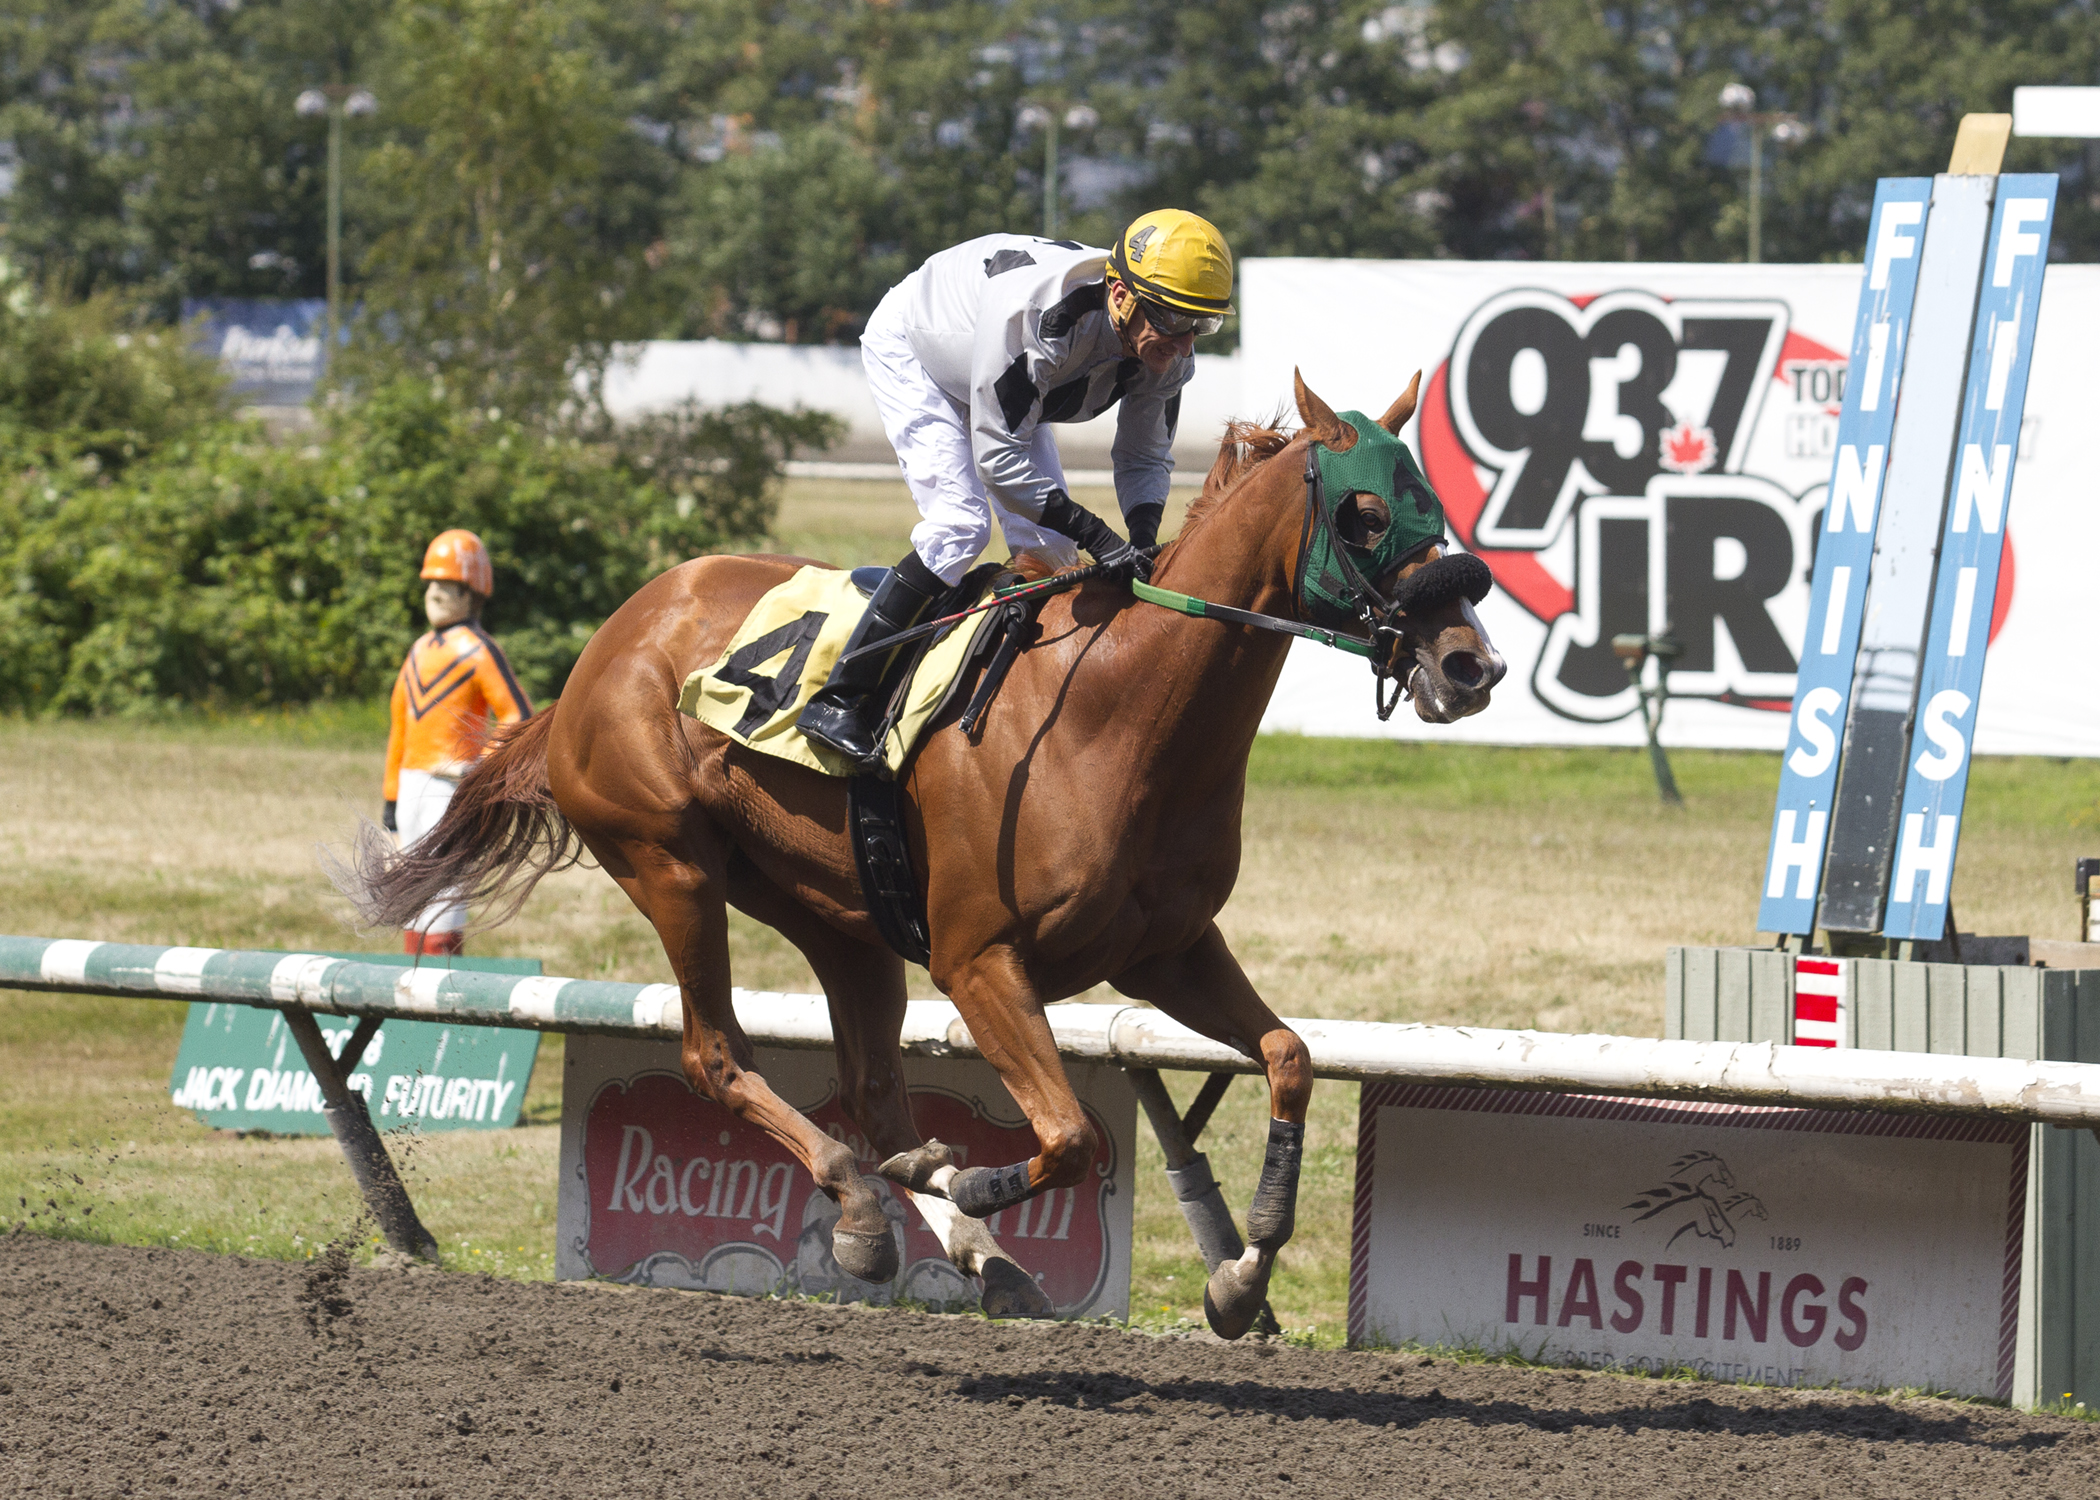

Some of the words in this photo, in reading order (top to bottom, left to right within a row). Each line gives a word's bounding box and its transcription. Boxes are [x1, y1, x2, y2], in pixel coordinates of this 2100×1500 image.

[1128, 224, 1158, 264] 4
[1766, 201, 1924, 900] FINISH
[1893, 198, 2049, 905] FINISH
[714, 611, 829, 740] 4
[172, 1066, 244, 1111] JACK
[245, 1067, 373, 1114] DIAMD
[381, 1074, 515, 1123] FUTURITY
[320, 1028, 384, 1067] 208
[608, 1123, 796, 1241] Racing
[1582, 1222, 1621, 1240] SINCE
[1770, 1235, 1802, 1252] 1889
[1504, 1252, 1869, 1352] HASTINGS
